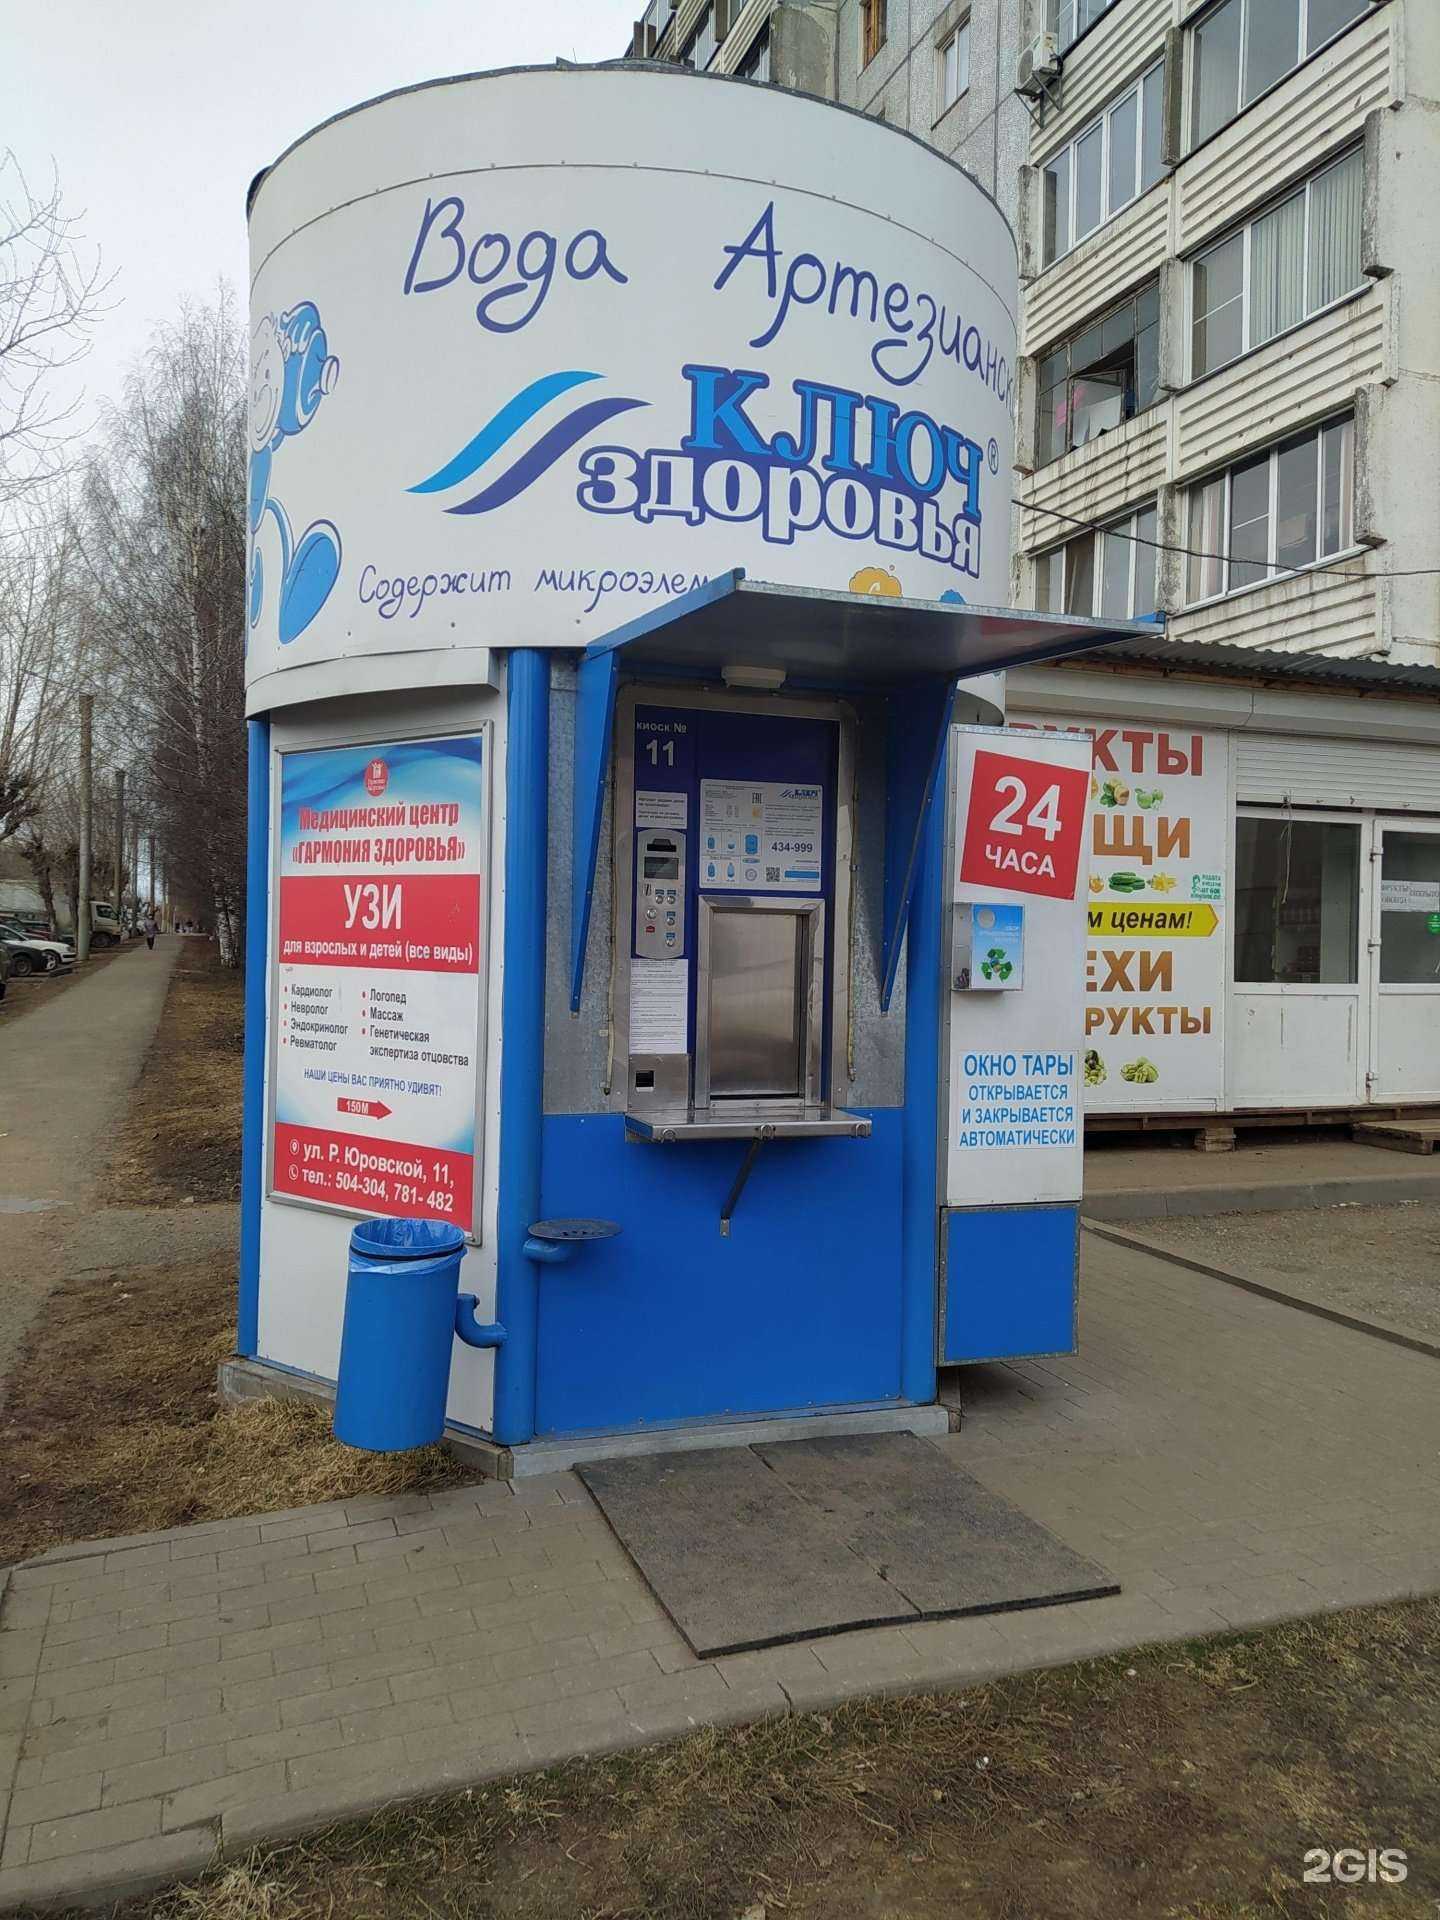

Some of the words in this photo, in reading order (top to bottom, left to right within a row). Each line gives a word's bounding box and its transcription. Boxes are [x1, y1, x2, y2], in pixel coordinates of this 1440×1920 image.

[404, 196, 628, 334] Вода
[358, 563, 511, 618] Содержит
[646, 739, 676, 767] 11
[298, 801, 406, 832] Медицинский
[409, 802, 459, 830] центр
[989, 776, 1061, 841] 24
[771, 841, 813, 853] 434-999
[1093, 814, 1190, 865] ЩИ
[985, 844, 1056, 878] ЧАСА
[343, 883, 402, 930] УЗИ
[1111, 910, 1193, 933] ценам!
[283, 940, 301, 955] для
[305, 941, 357, 959] взрослых
[360, 944, 366, 956] и
[369, 941, 401, 960] детей
[405, 941, 431, 962] (все
[434, 943, 472, 965] виды)
[291, 984, 332, 999] Кардиолог
[370, 989, 406, 1005] Логопед
[291, 1001, 328, 1016] Невролог
[370, 1008, 403, 1022] Массаж
[290, 1019, 348, 1036] Эндокринолог
[1085, 1007, 1211, 1036] РУКТЫ
[290, 1035, 337, 1052] Ревматолог
[370, 1027, 430, 1043] Генетическая
[369, 1045, 418, 1062] экспертиза
[421, 1052, 469, 1067] отцовства
[964, 1054, 1017, 1077] ОКНО
[1021, 1054, 1073, 1077] ТАРЫ
[304, 1068, 326, 1081] НАШИ
[328, 1071, 350, 1085] ЦЕНЫ
[351, 1074, 367, 1086] ВАС
[369, 1076, 405, 1092] ПРИЯТНО
[407, 1081, 442, 1097] УДИВЯТ!
[968, 1084, 1068, 1101] ОТКРЫВАЕТСЯ
[346, 1100, 369, 1115] 150М
[962, 1109, 971, 1124] И
[975, 1106, 1073, 1124] ЗАКРЫВАЕТСЯ
[959, 1129, 1075, 1147] АВТОМАТИЧЕСКИ
[303, 1145, 324, 1162] ул.
[329, 1144, 340, 1162] Р.
[344, 1149, 427, 1182] Юровской,
[433, 1162, 454, 1189] 11,
[335, 1171, 388, 1203] 504-304,
